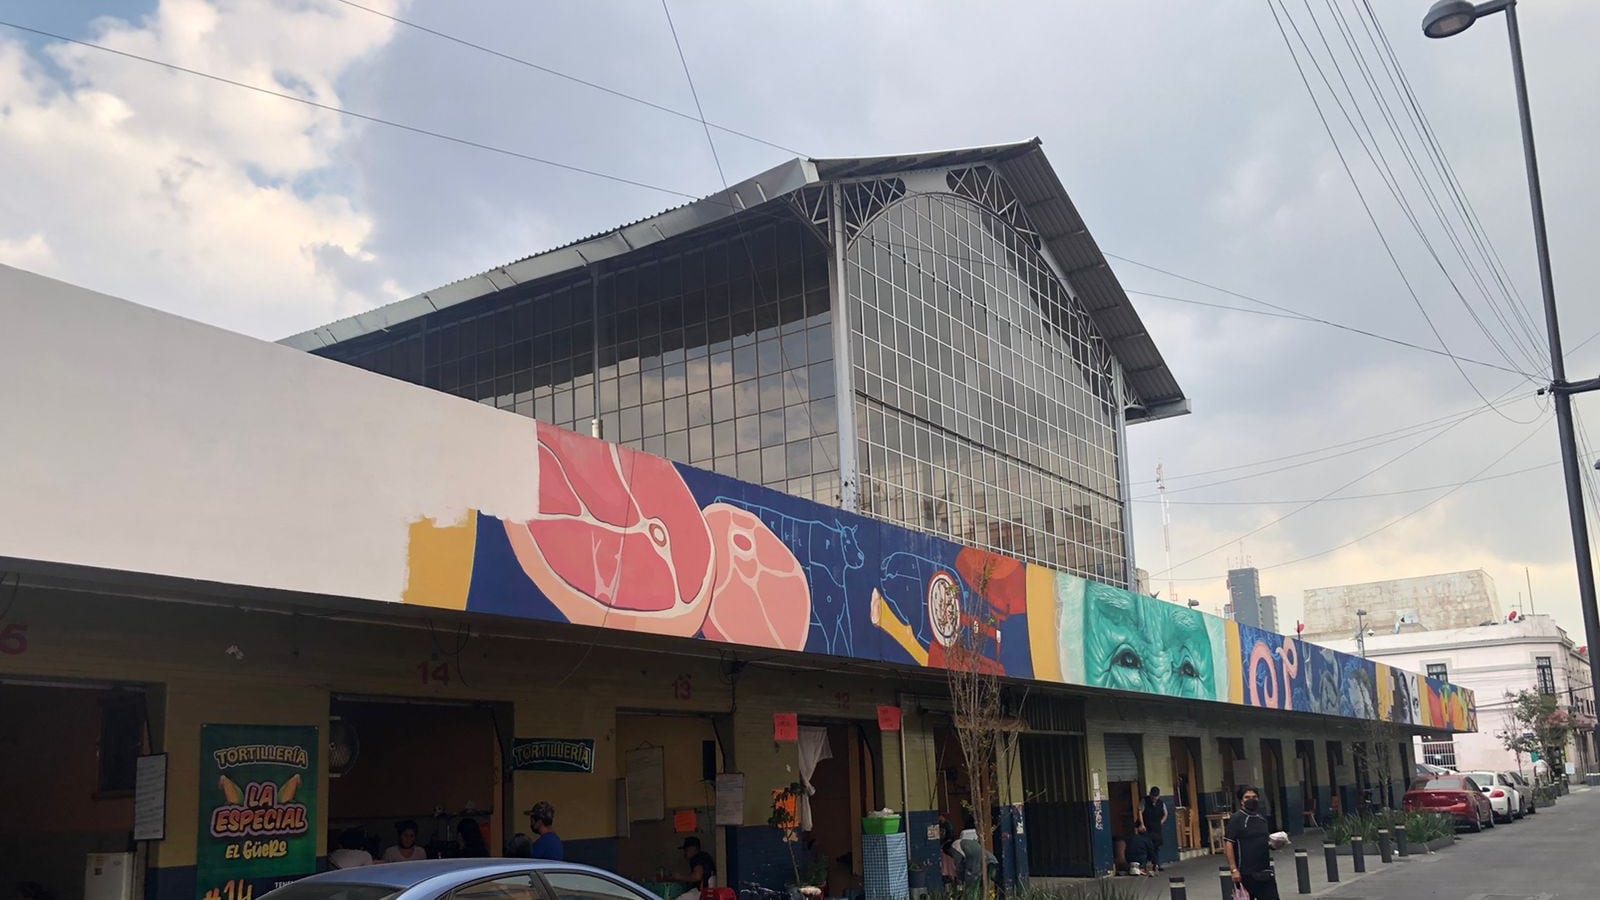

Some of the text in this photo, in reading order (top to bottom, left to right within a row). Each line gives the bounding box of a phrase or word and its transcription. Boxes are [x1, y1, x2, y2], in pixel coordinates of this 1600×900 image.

[417, 661, 449, 686] 14
[671, 679, 692, 700] 13
[833, 691, 850, 710] 12
[216, 746, 307, 768] TORTILLERÍA
[516, 743, 590, 766] TORTILLERÍA
[247, 784, 275, 807] LA
[214, 807, 306, 833] ESPECIAL
[225, 843, 241, 859] EL
